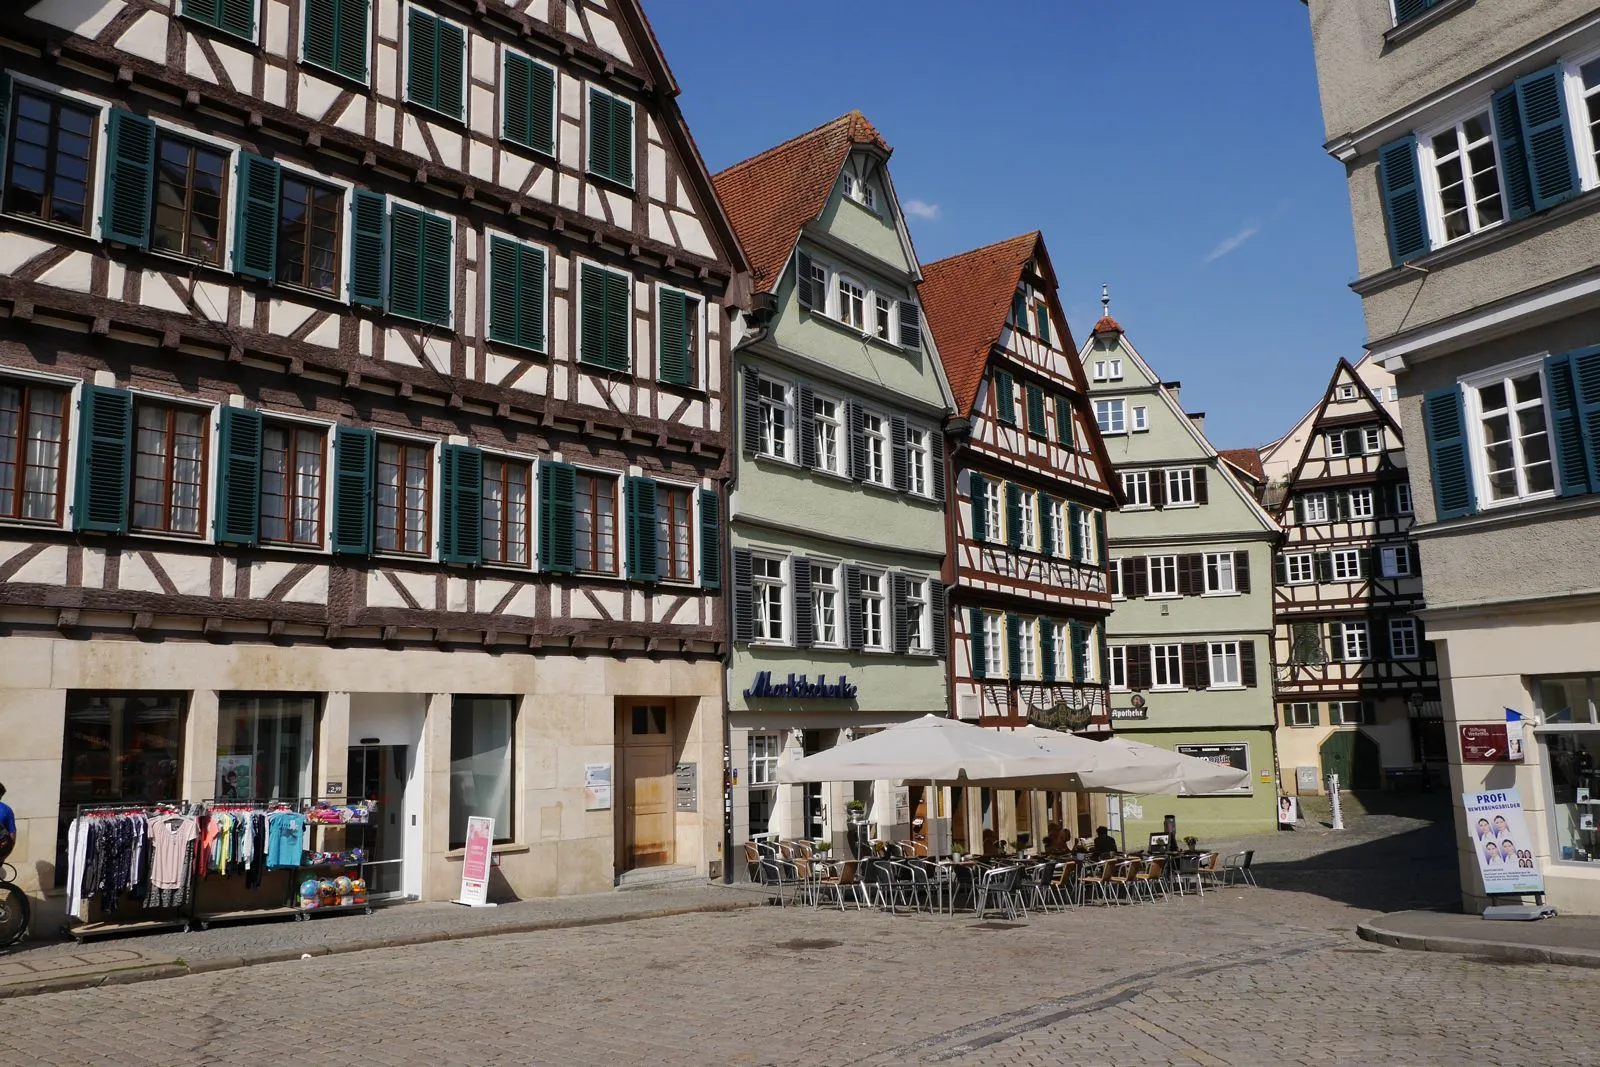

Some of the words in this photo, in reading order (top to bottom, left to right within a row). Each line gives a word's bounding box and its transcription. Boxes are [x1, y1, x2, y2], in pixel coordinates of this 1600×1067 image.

[743, 671, 857, 698] Marktschenke
[1111, 709, 1143, 718] Apotheke
[1476, 792, 1507, 804] PROFI
